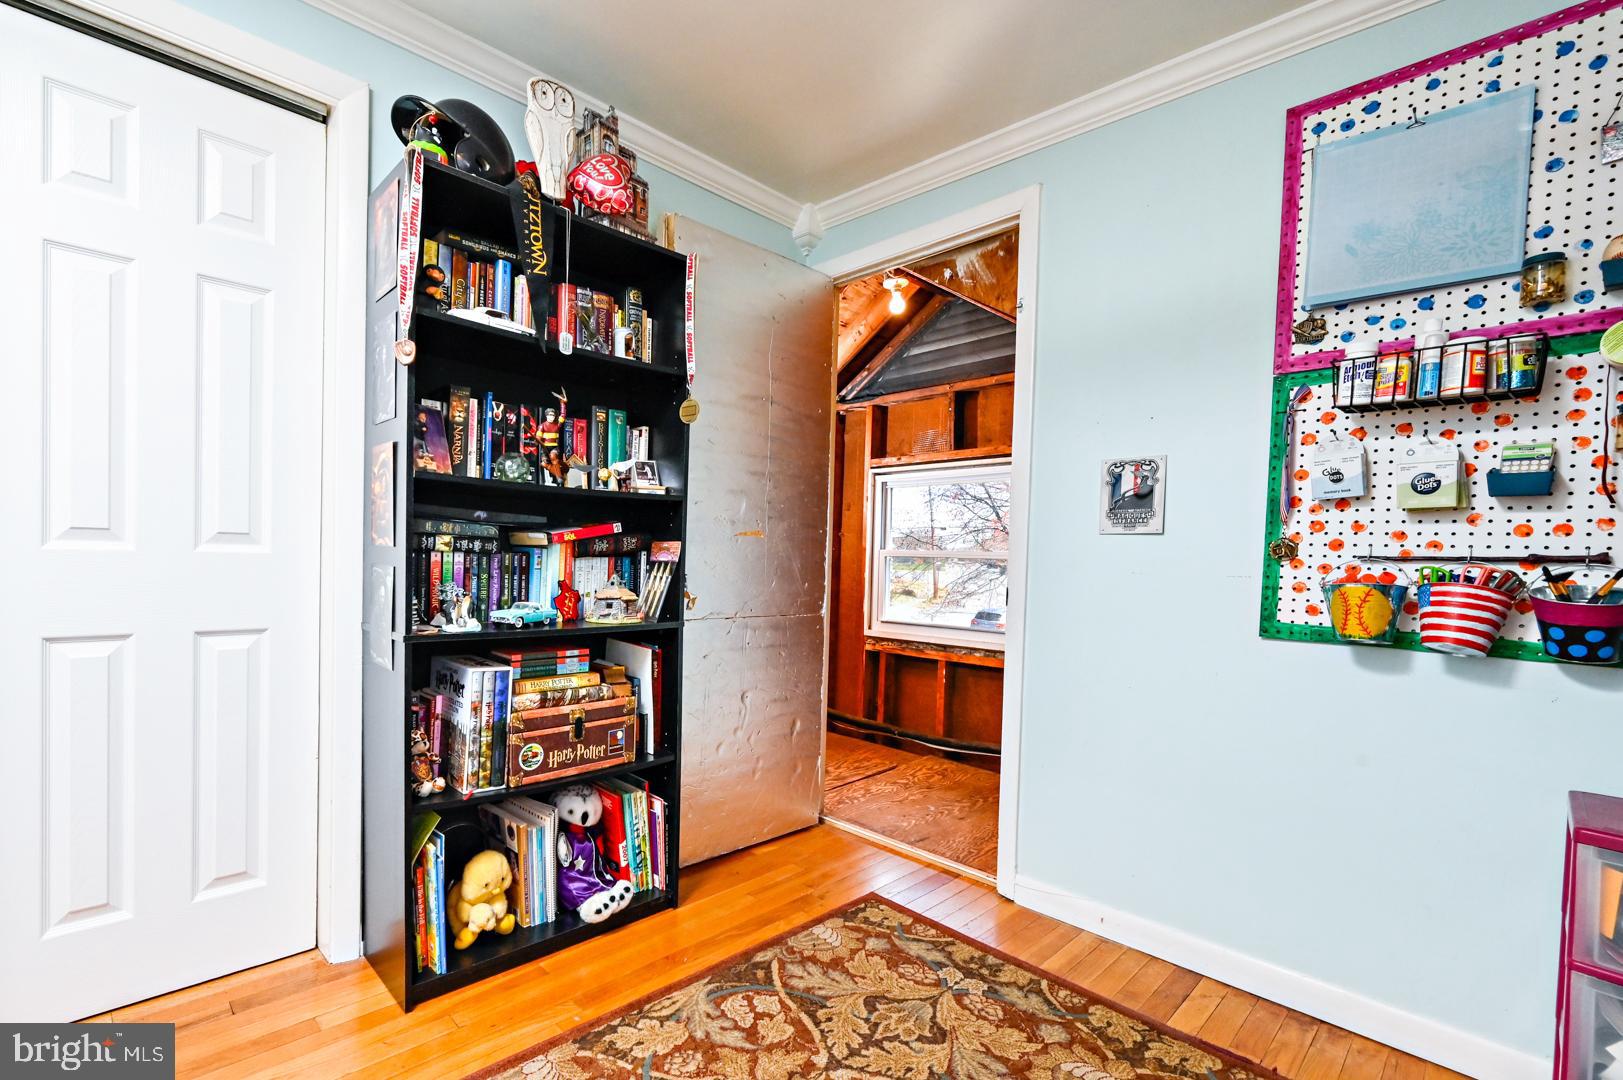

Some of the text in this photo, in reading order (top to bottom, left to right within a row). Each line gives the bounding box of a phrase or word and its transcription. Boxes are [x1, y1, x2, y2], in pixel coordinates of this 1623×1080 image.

[592, 156, 615, 181] Love
[409, 196, 421, 238] SOFTBALL
[400, 211, 409, 251] SOFTBALL
[523, 190, 531, 275] NIVERSITY
[400, 263, 409, 305] SOFTBALL
[454, 278, 466, 298] City
[452, 424, 464, 465] NARNIA
[1322, 466, 1342, 476] Glue
[1414, 476, 1436, 485] Glue
[1417, 482, 1438, 491] Dots
[530, 677, 574, 689] HARRY POTTER
[548, 743, 606, 768] Harry Potter
